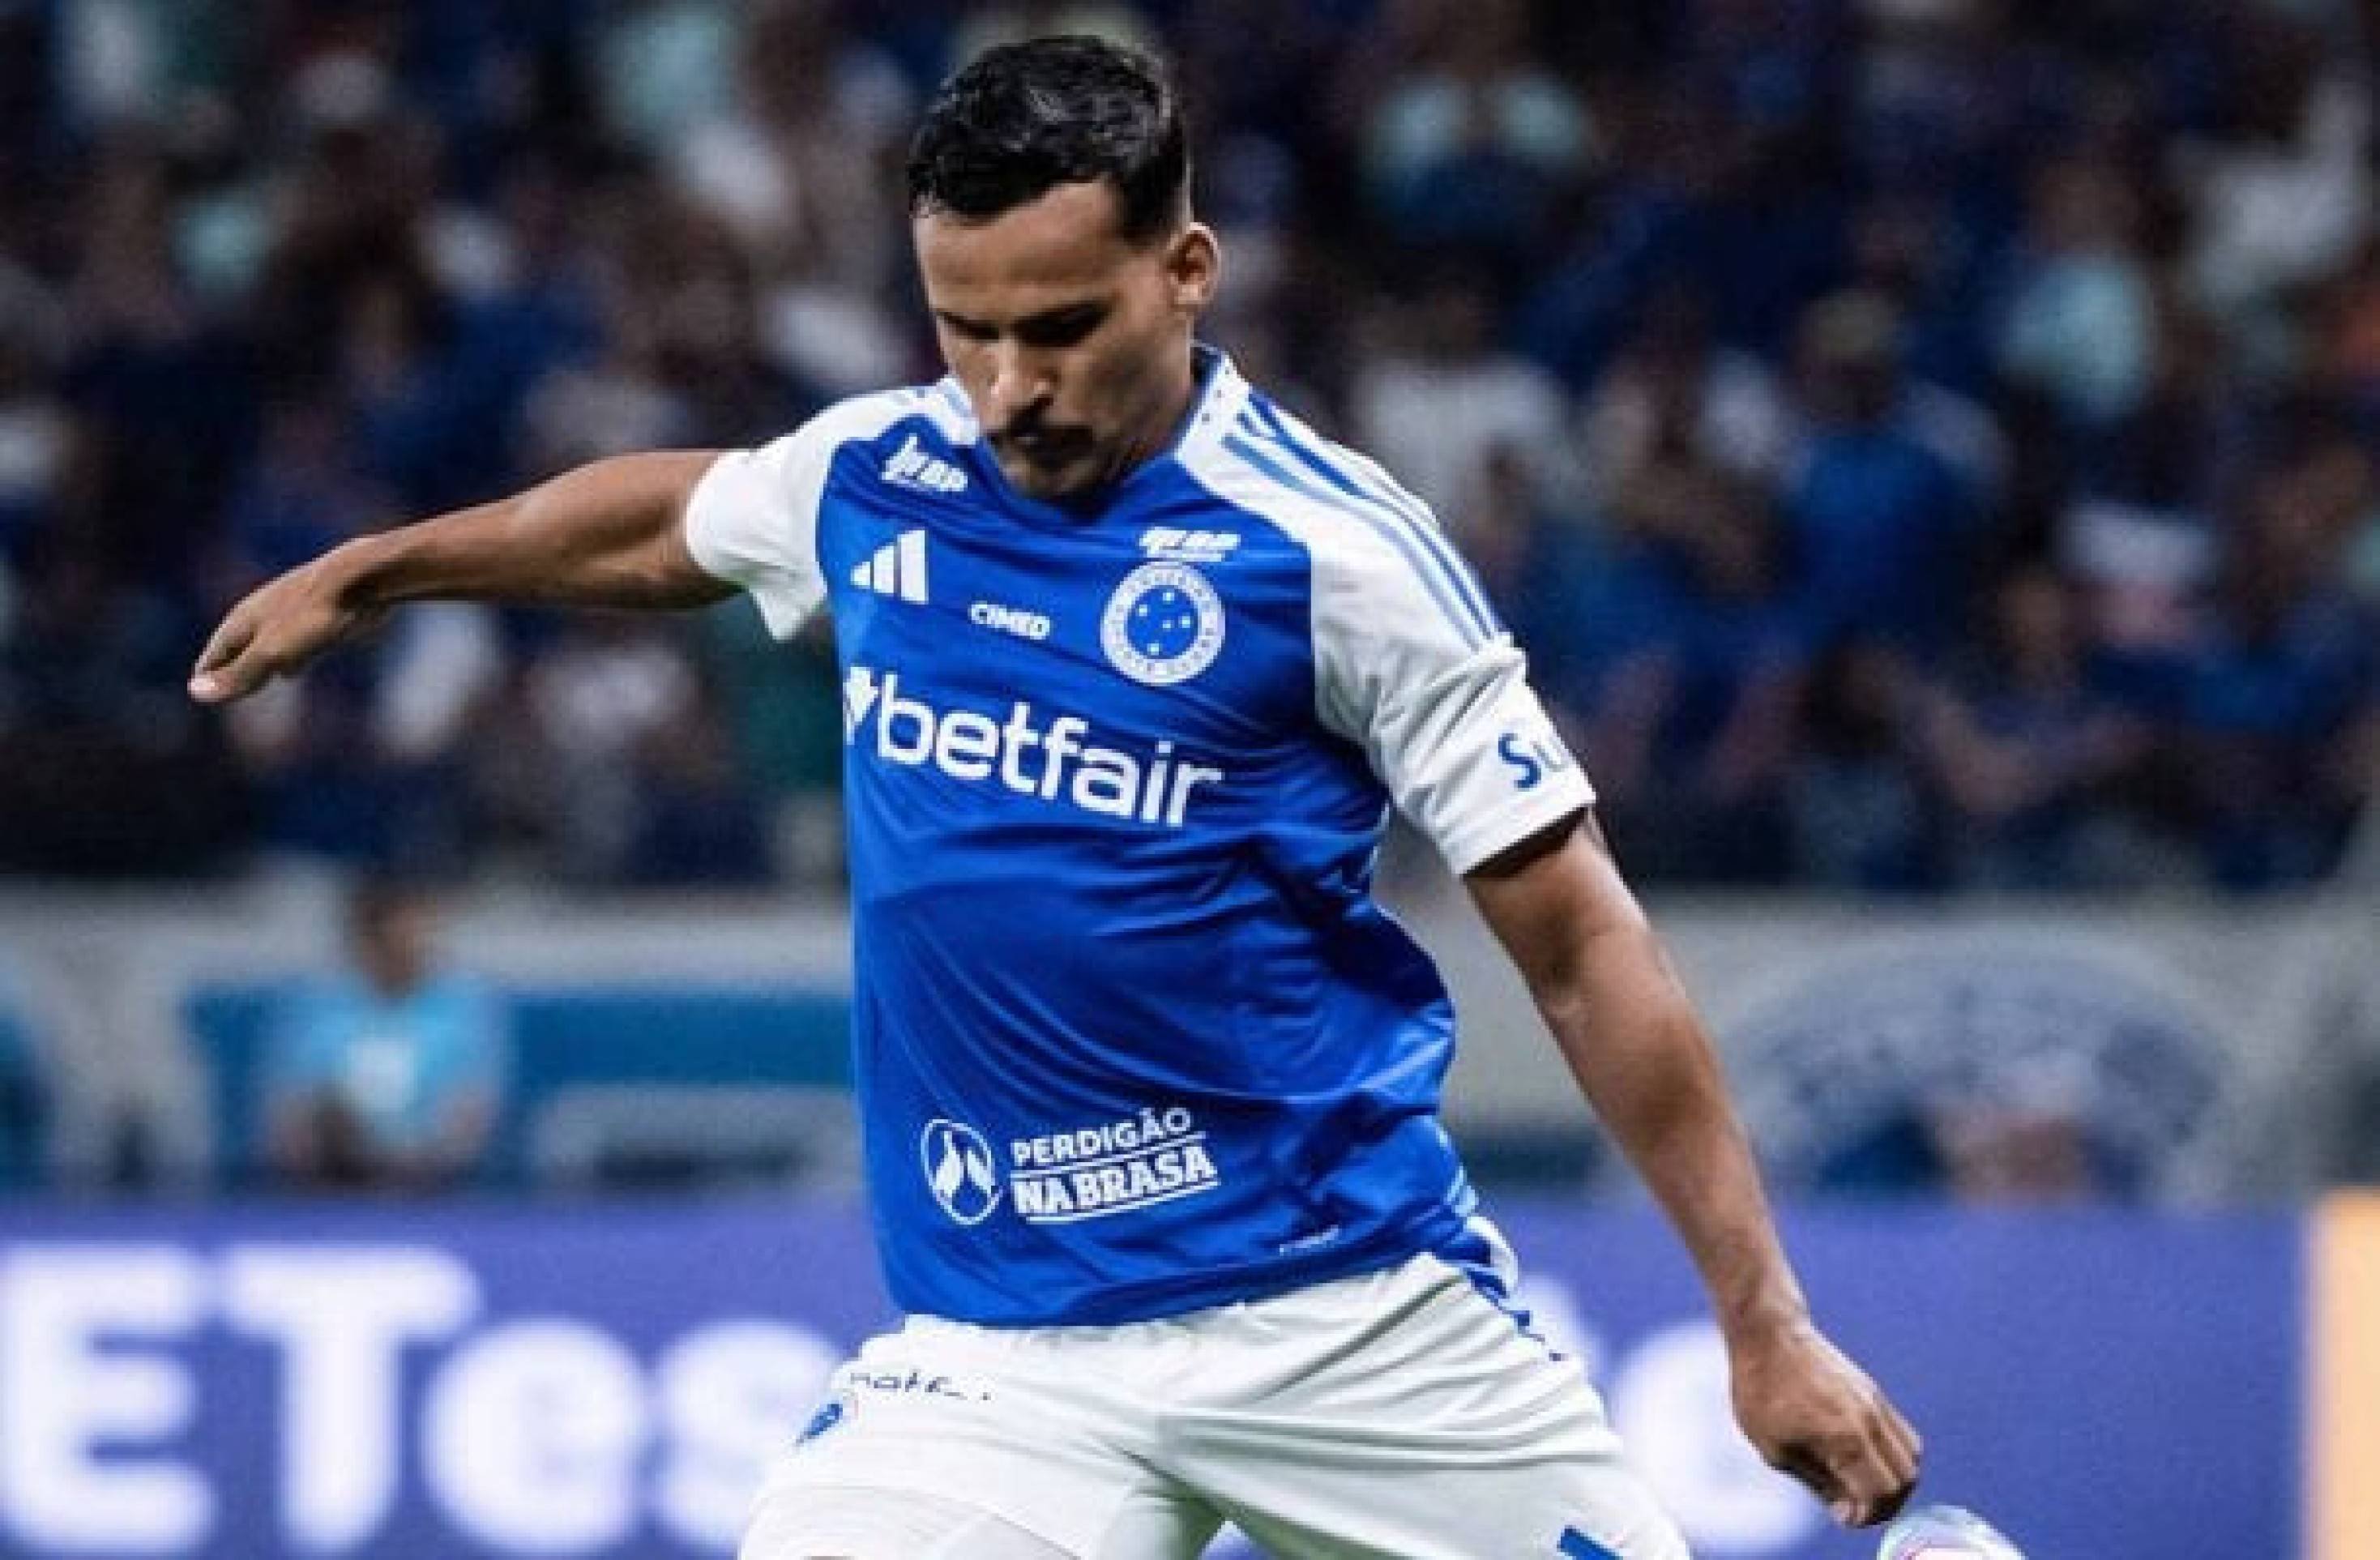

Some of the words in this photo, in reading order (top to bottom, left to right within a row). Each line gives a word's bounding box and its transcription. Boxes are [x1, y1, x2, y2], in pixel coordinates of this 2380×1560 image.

[971, 600, 1051, 640] CIMED
[878, 672, 1222, 827] betfair
[1011, 1107, 1191, 1164] PERDIGÃO
